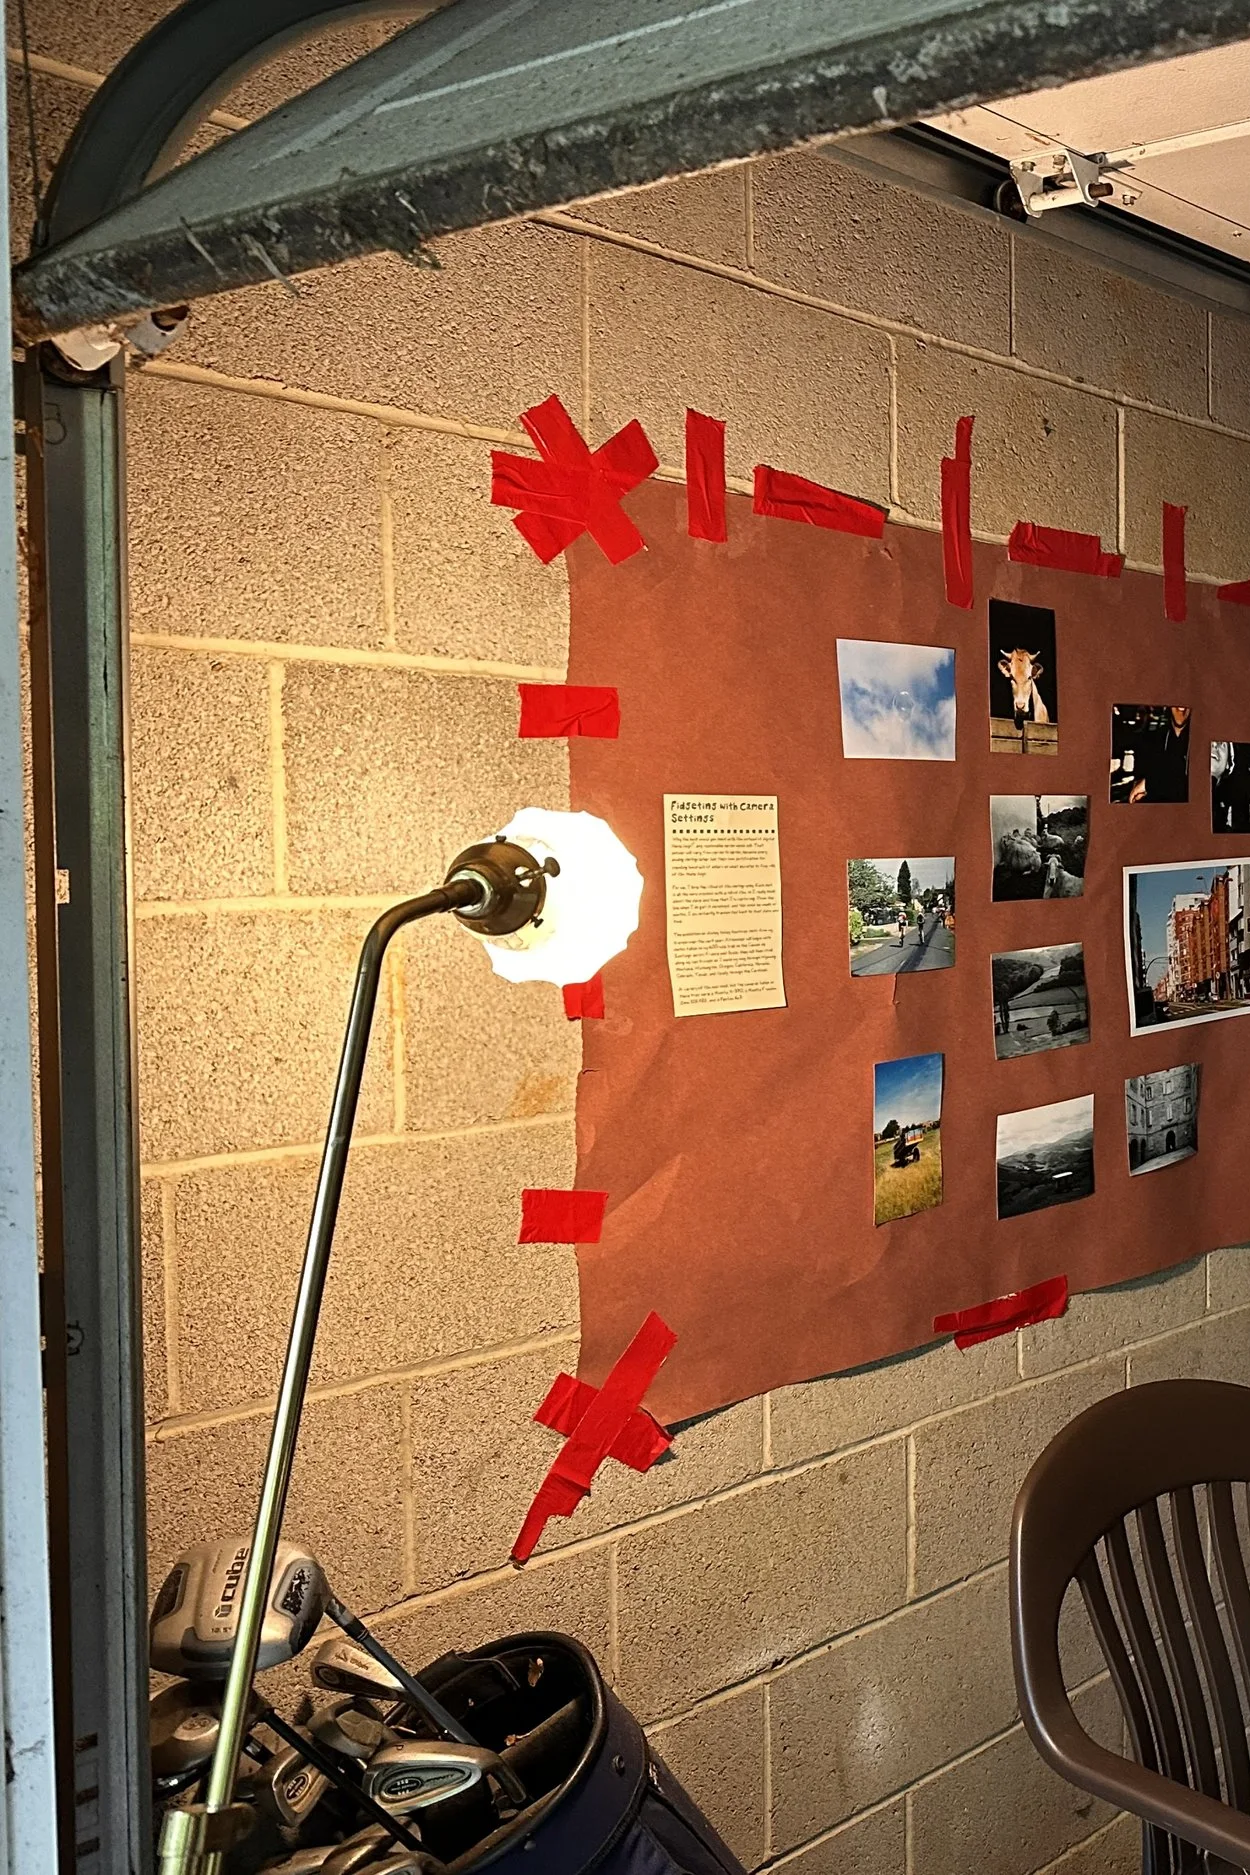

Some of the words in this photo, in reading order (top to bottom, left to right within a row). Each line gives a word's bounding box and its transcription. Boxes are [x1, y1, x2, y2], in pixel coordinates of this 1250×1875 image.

[670, 800, 717, 811] Fidgeting
[719, 801, 738, 810] with
[739, 801, 774, 811] Camera
[671, 813, 714, 823] Settings
